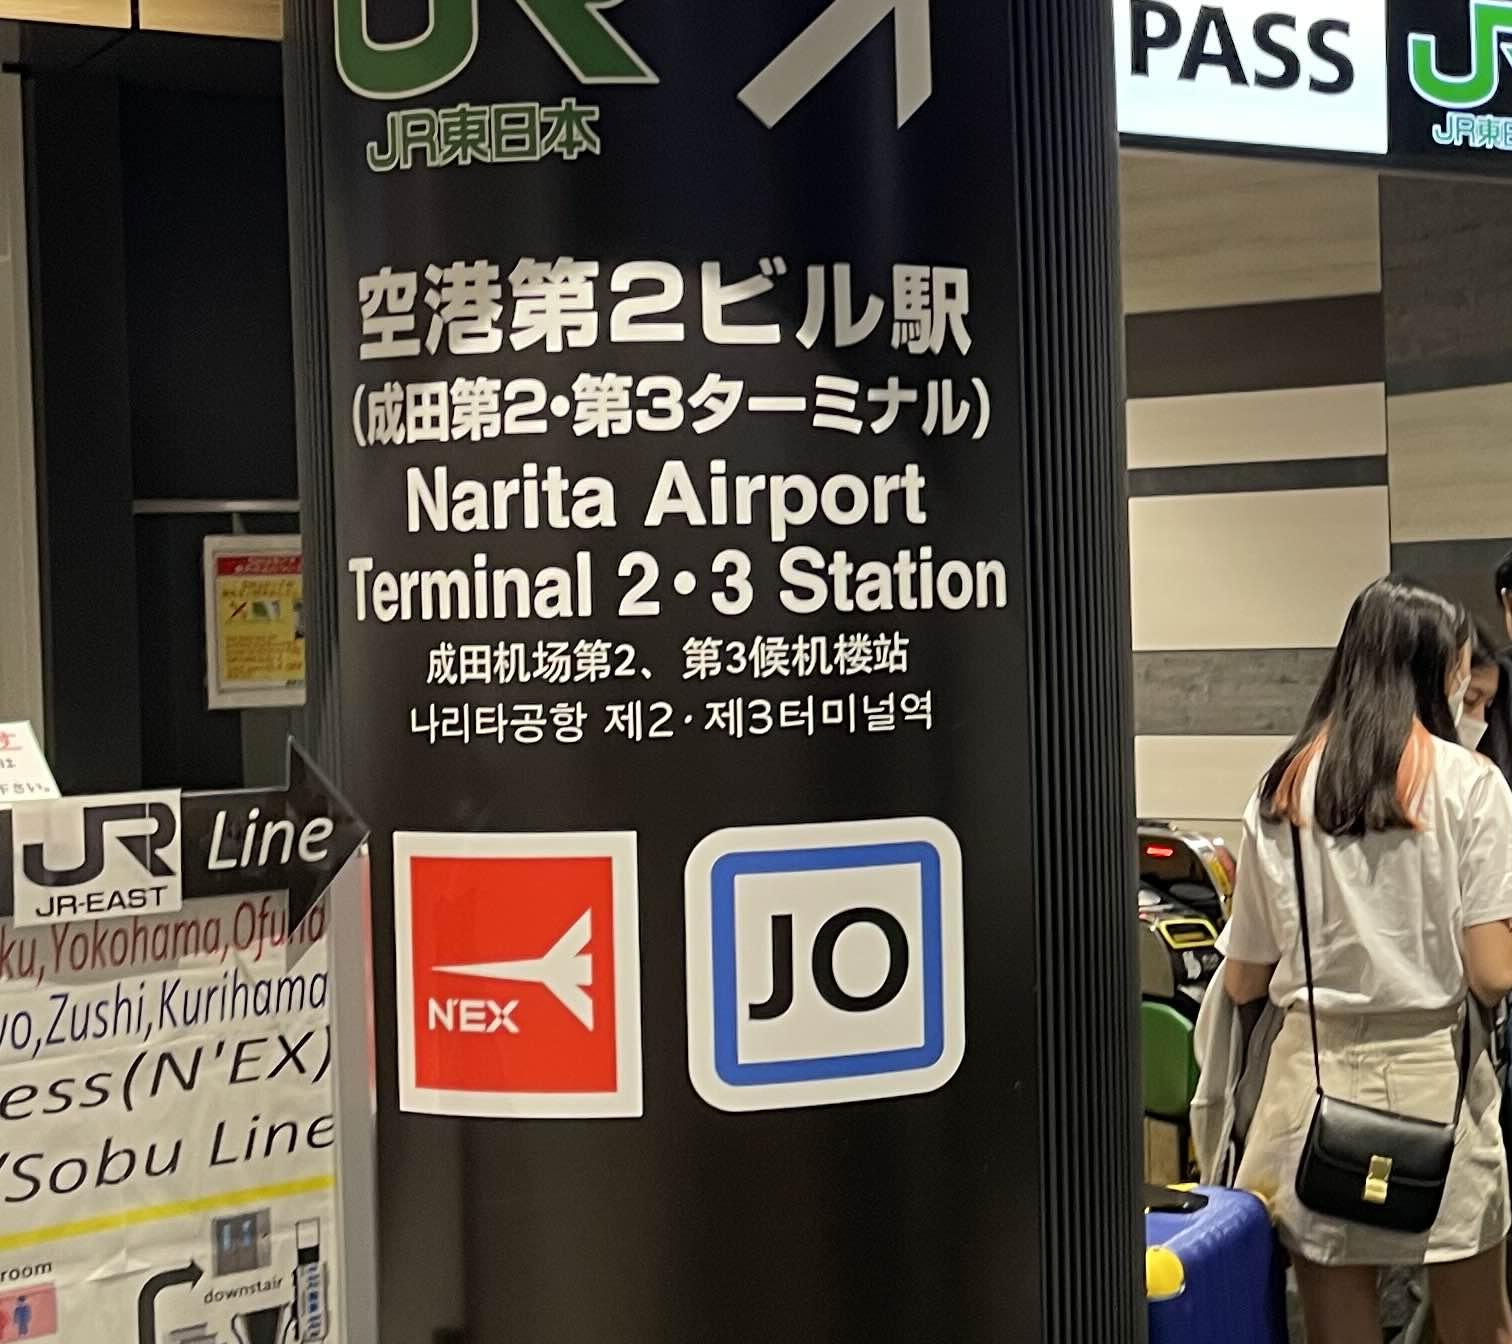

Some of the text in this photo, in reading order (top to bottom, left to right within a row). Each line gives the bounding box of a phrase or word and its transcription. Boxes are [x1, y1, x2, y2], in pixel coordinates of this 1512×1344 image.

[367, 97, 601, 173] JR東日本
[357, 256, 973, 362] 空港第2ビル駅
[406, 459, 927, 542] Narita Airport
[349, 551, 592, 623] Terminal
[780, 546, 1008, 611] Station
[409, 698, 587, 746] 나리타공항
[23, 802, 336, 888] JR Line
[36, 886, 168, 918] JR-EAST
[748, 906, 910, 1022] JO
[208, 1114, 335, 1168] Line
[203, 1276, 284, 1306] downstair
